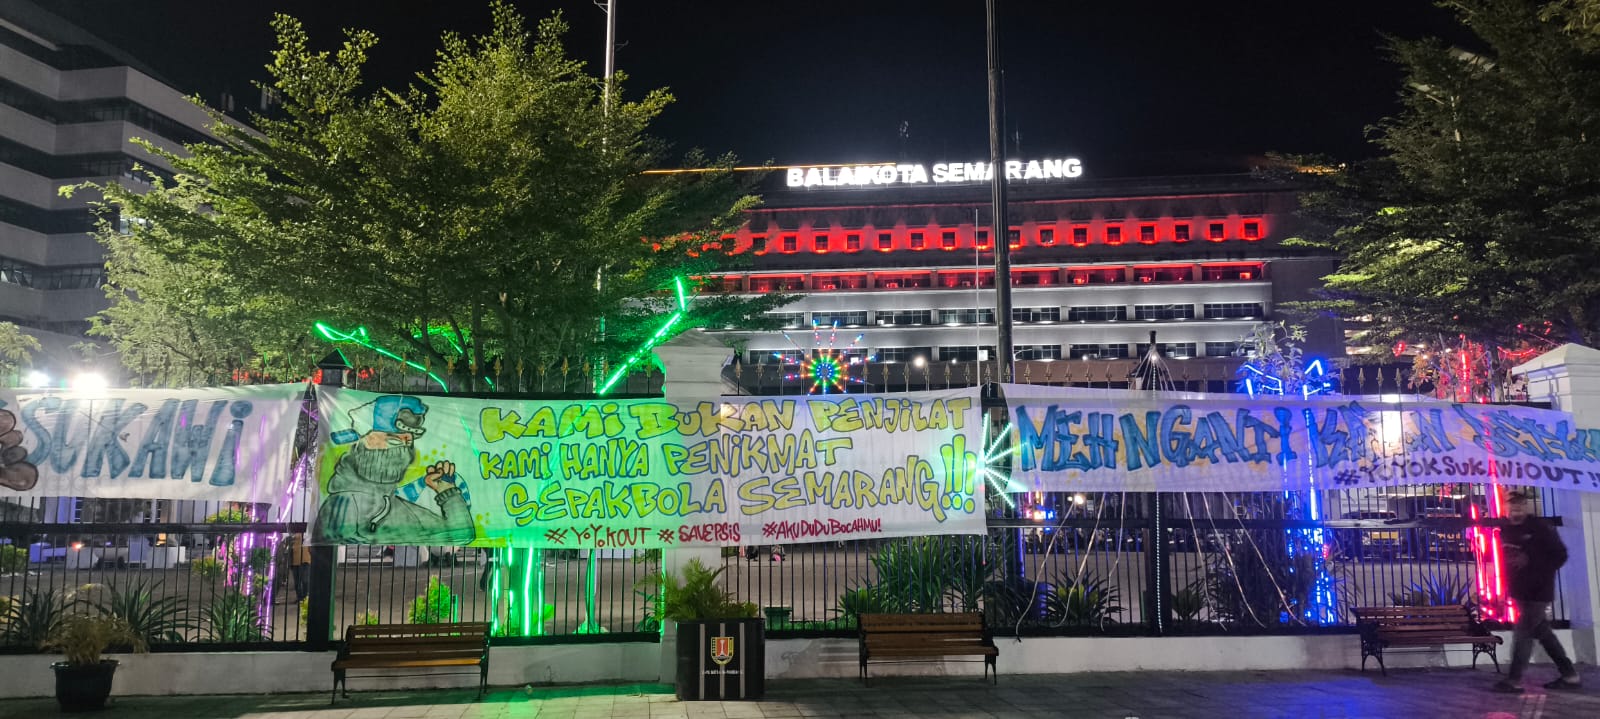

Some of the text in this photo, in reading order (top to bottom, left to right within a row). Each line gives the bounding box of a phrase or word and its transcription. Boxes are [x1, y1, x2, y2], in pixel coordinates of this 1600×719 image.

[786, 163, 928, 188] BALAIKOTA
[559, 437, 649, 479] HANYA
[503, 478, 727, 527] SEPAKBOLA
